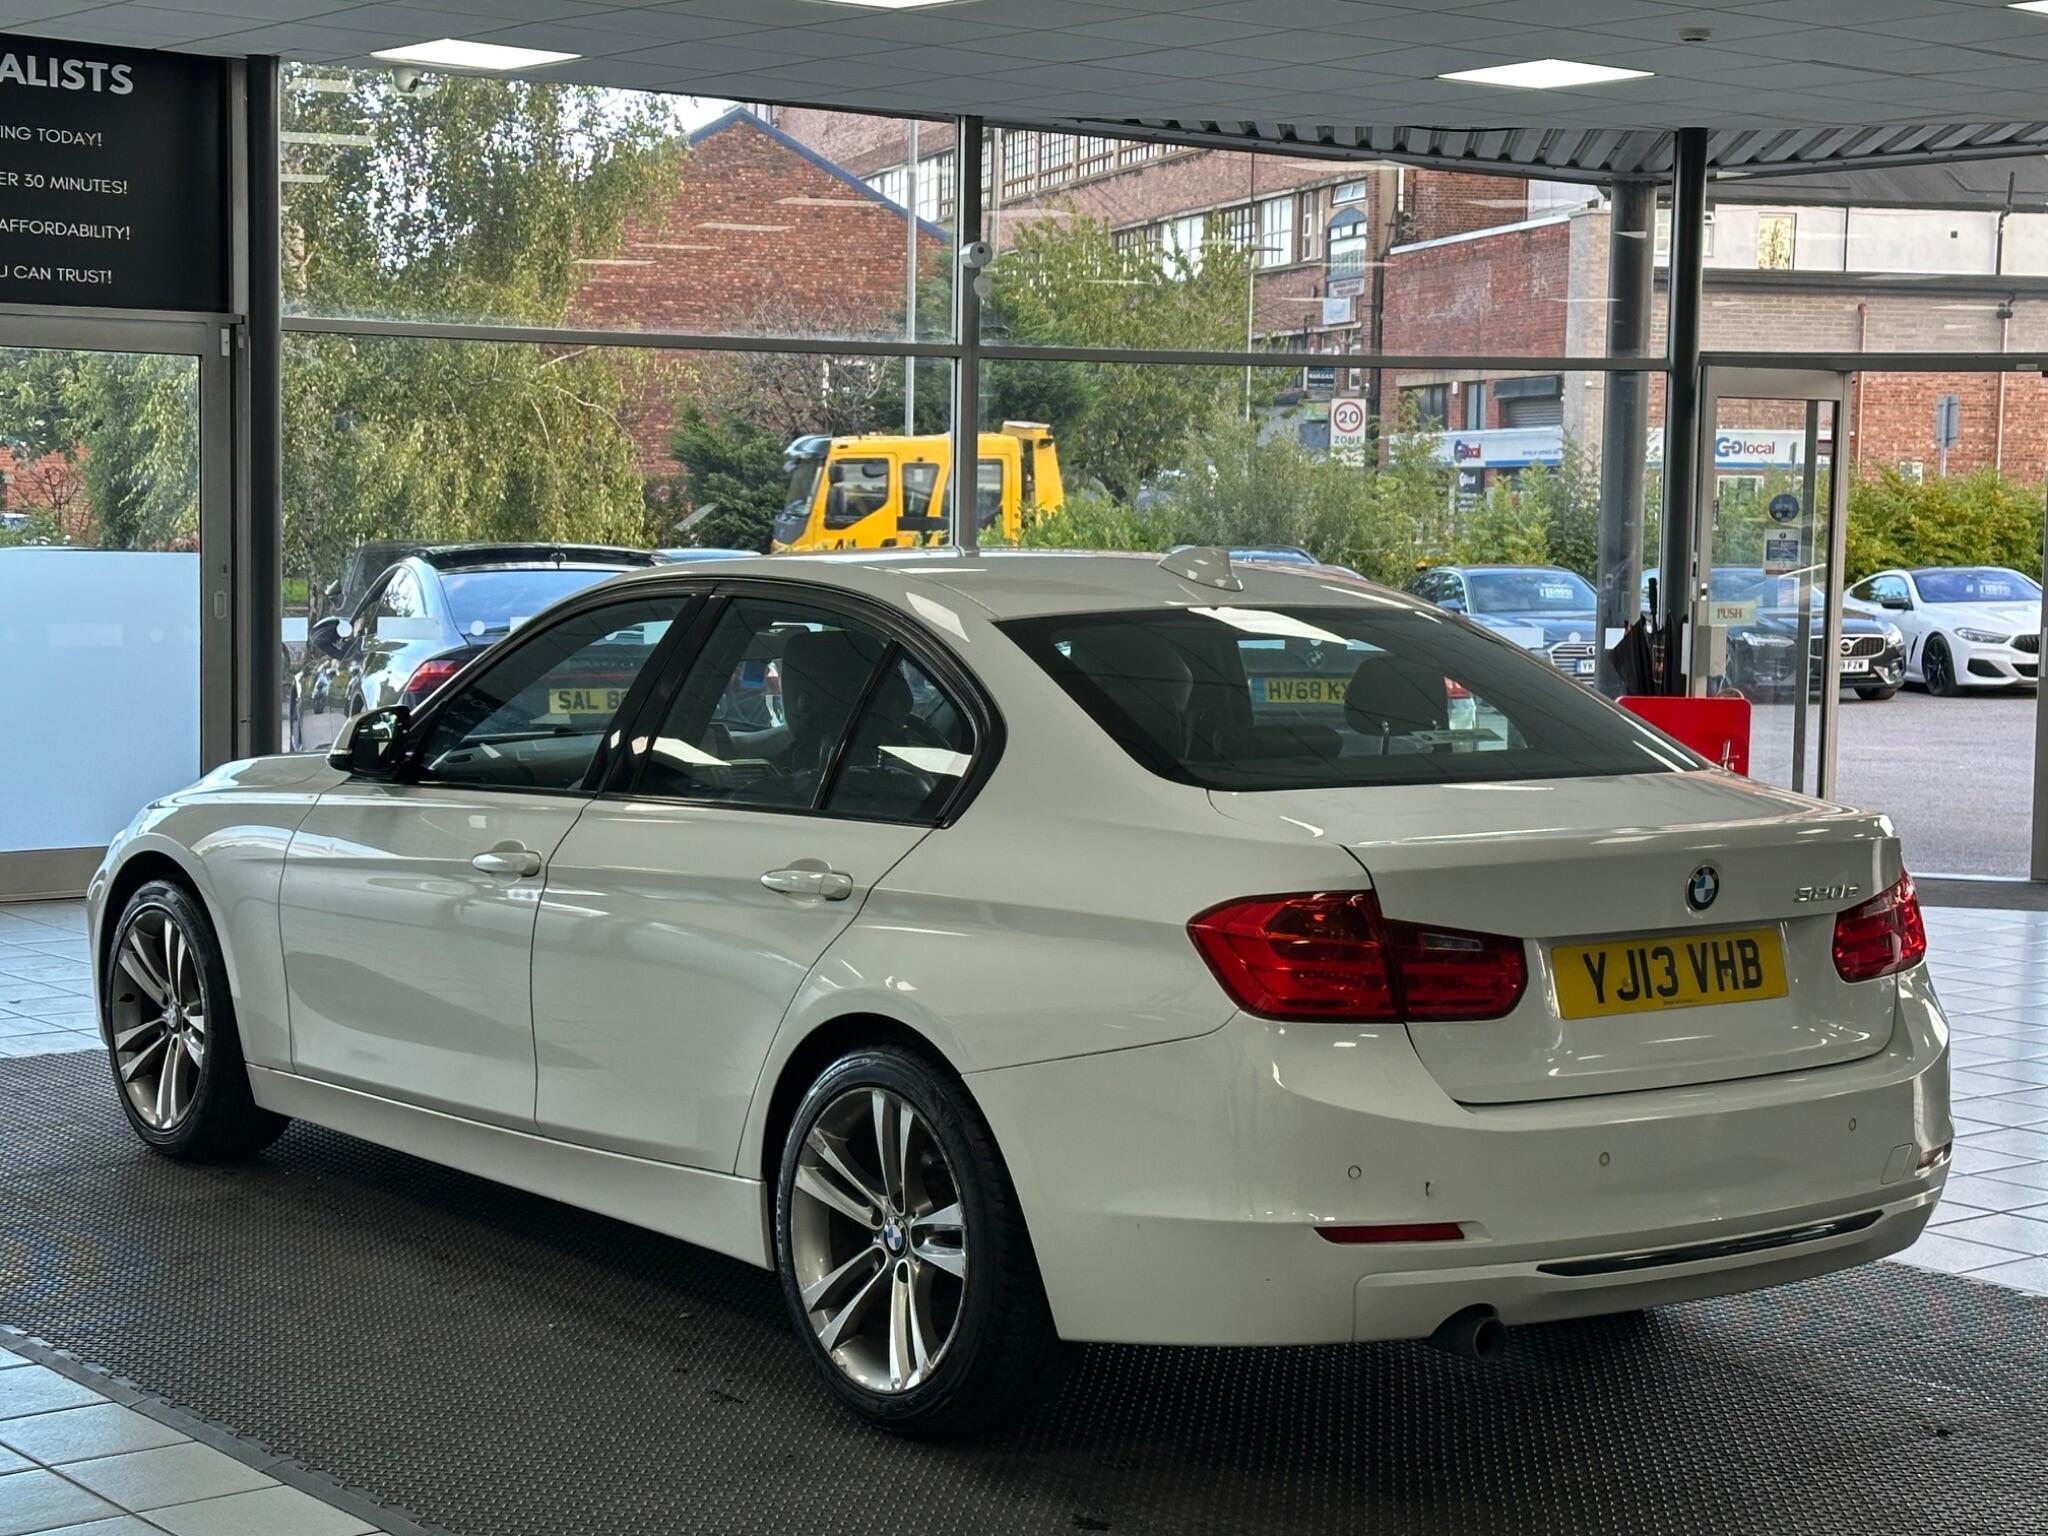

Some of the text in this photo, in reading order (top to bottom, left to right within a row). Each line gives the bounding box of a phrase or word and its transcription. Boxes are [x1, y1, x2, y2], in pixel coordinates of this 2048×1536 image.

[0, 53, 134, 95] ALISTS
[37, 128, 103, 146] TODAY!
[24, 174, 45, 188] 30
[50, 177, 128, 194] MINUTES!
[0, 219, 130, 240] AFFORDABILITY!
[13, 265, 51, 280] CAN
[56, 267, 112, 284] TRUST!
[1338, 410, 1359, 424] 20
[1334, 435, 1361, 445] ZONE
[1717, 608, 1743, 619] PUSH
[558, 690, 600, 710] SAL
[1268, 681, 1321, 700] HV68
[1582, 938, 1764, 1004] YJ13 VHB
